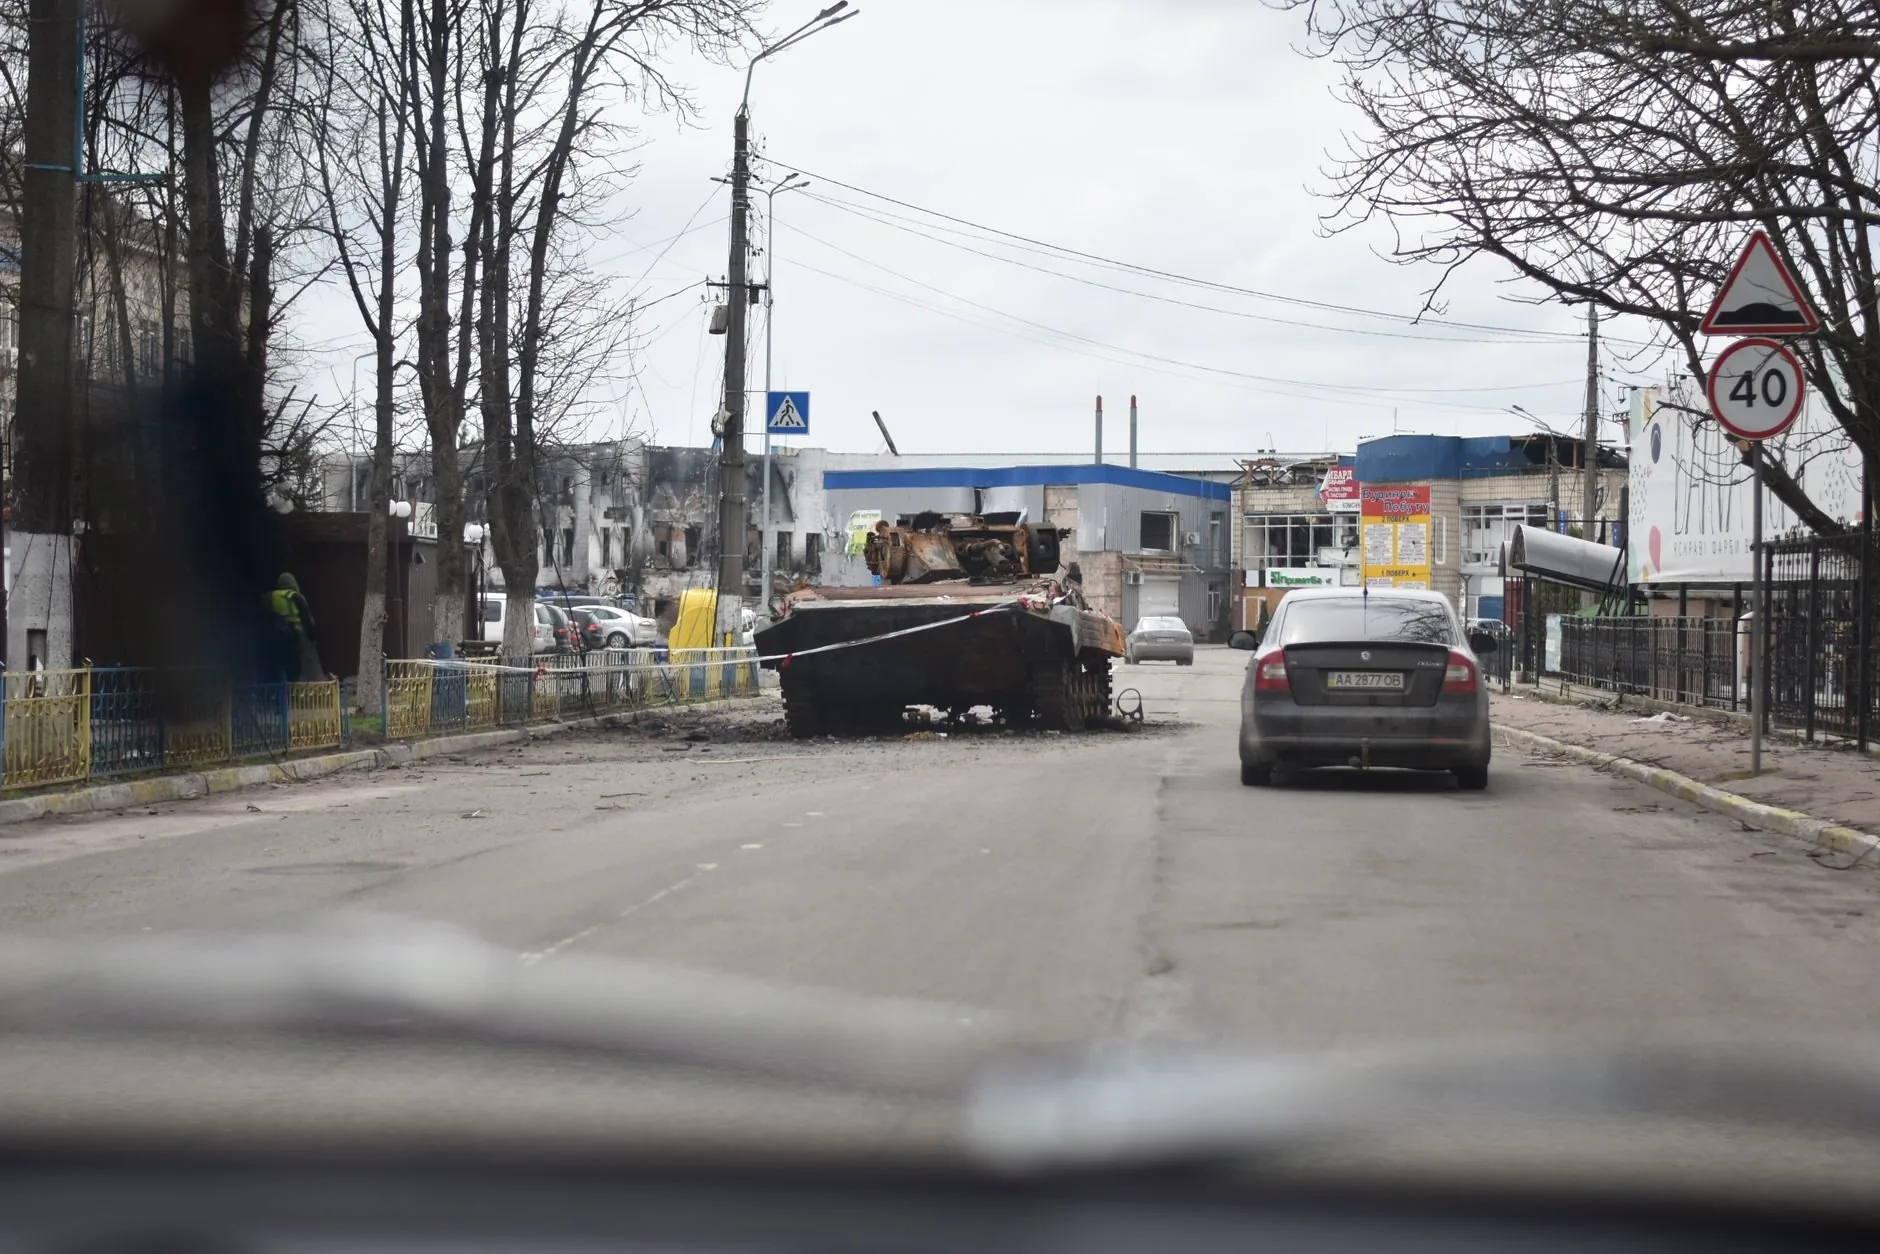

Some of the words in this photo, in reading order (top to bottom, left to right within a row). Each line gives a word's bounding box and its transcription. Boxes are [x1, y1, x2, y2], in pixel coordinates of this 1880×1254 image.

[1729, 368, 1787, 408] 40
[1384, 500, 1430, 514] Побуту
[1386, 569, 1410, 577] ПОВЕРХ
[1335, 674, 1352, 686] AA
[1355, 674, 1382, 686] 2877
[1384, 674, 1401, 687] OB
